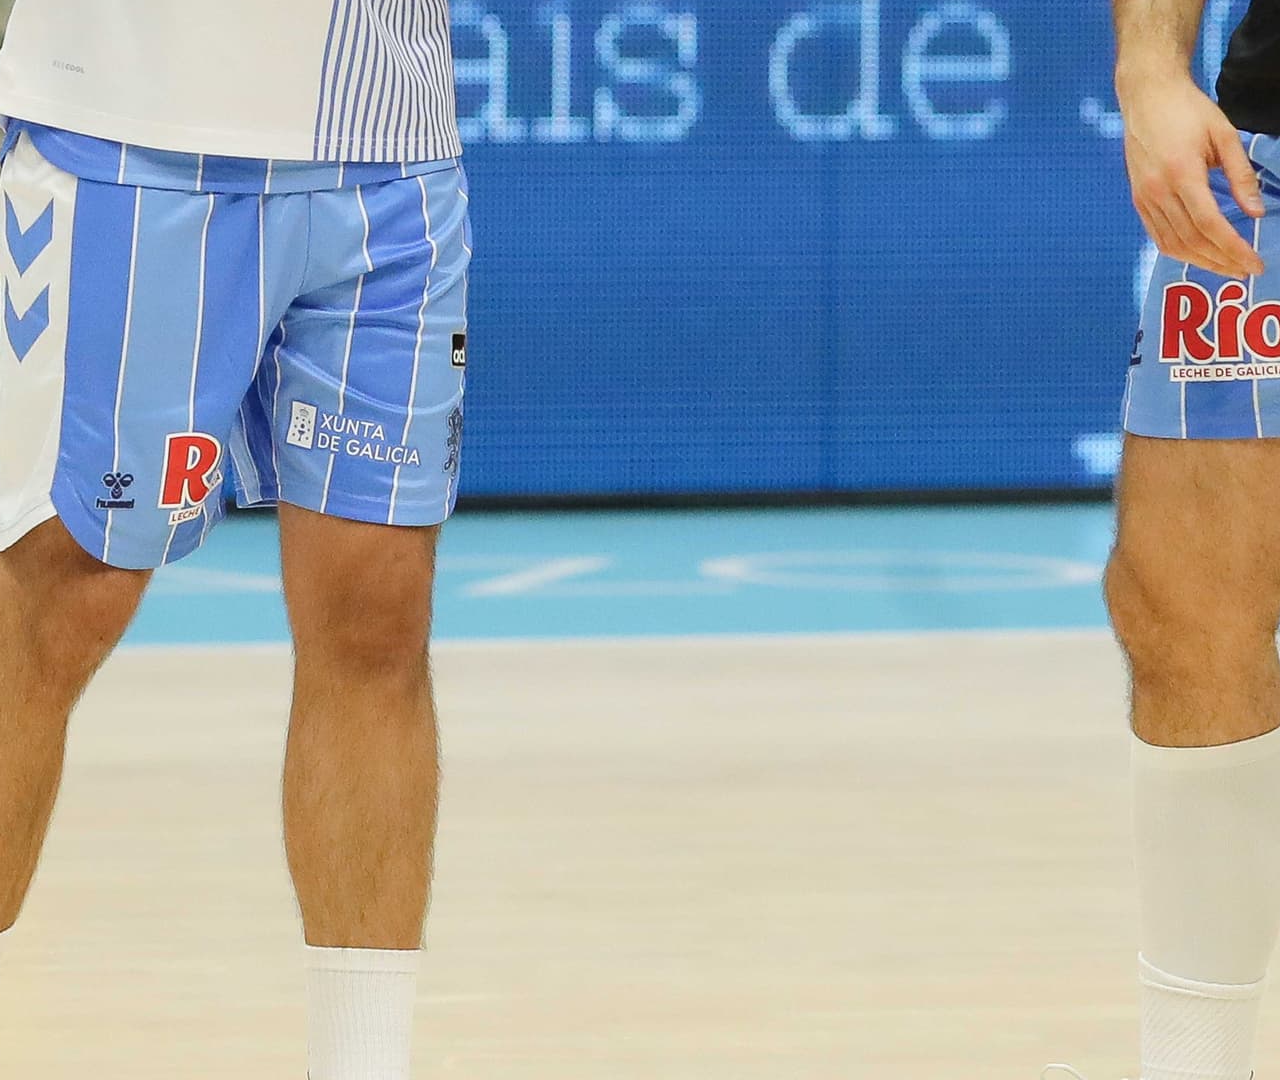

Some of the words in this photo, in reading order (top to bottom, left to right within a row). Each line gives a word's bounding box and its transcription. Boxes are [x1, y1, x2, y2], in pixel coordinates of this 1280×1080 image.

[1173, 368, 1211, 378] LECHE
[1215, 367, 1233, 377] DE
[320, 414, 385, 441] XUNTA
[317, 432, 341, 452] DE
[346, 439, 420, 465] GALICIA
